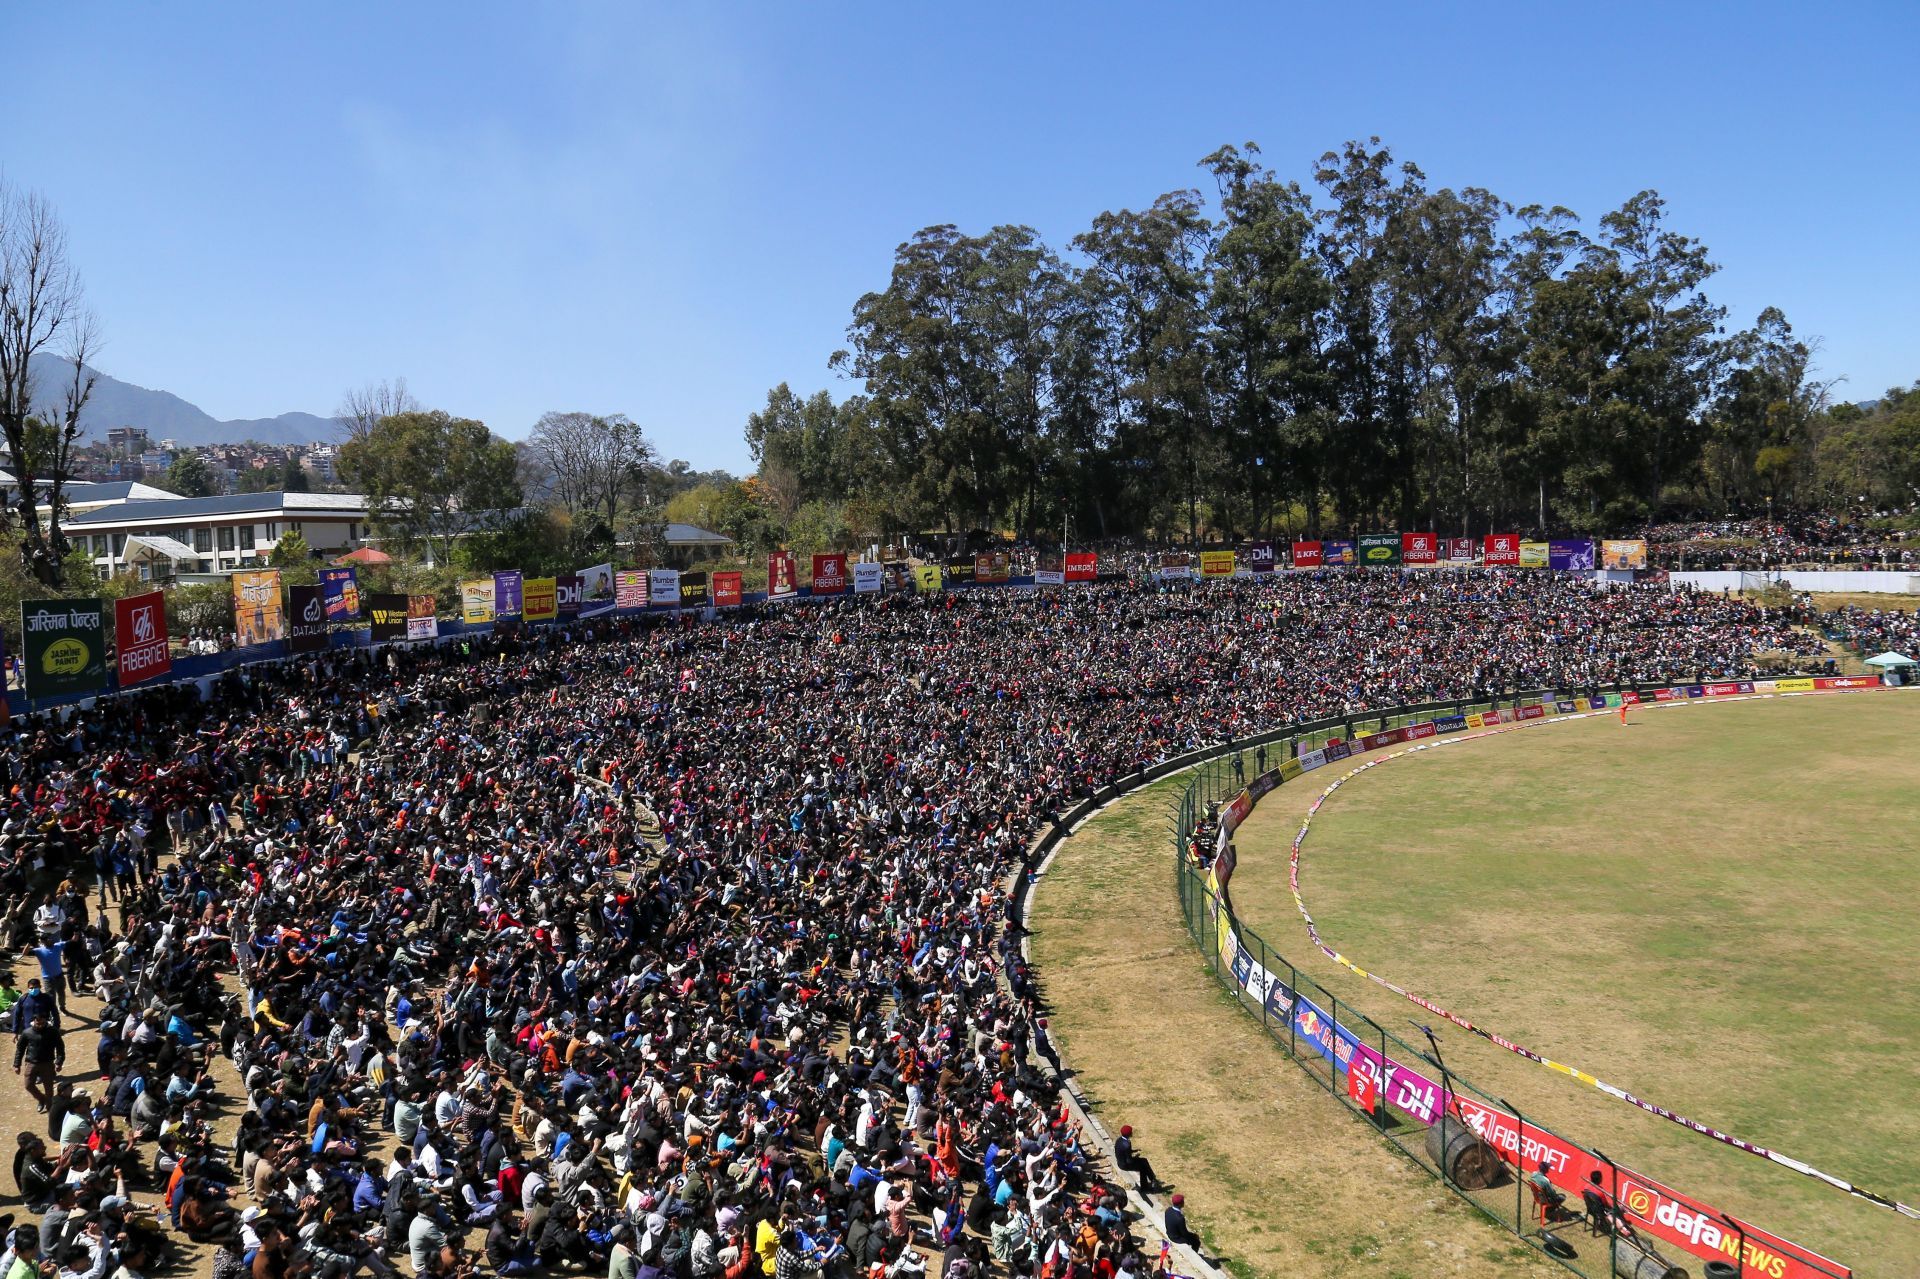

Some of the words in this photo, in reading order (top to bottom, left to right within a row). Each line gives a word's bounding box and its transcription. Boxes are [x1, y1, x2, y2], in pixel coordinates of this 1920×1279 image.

[1303, 550, 1319, 558] KFC
[1403, 551, 1436, 560] FIBERNET
[1486, 552, 1518, 560] FIBERNET
[815, 577, 844, 588] FIBERNET
[51, 648, 81, 659] JASMINE
[121, 642, 167, 673] FIBERNET
[55, 656, 79, 666] PAINTS
[1493, 1125, 1570, 1173] FIBERNET
